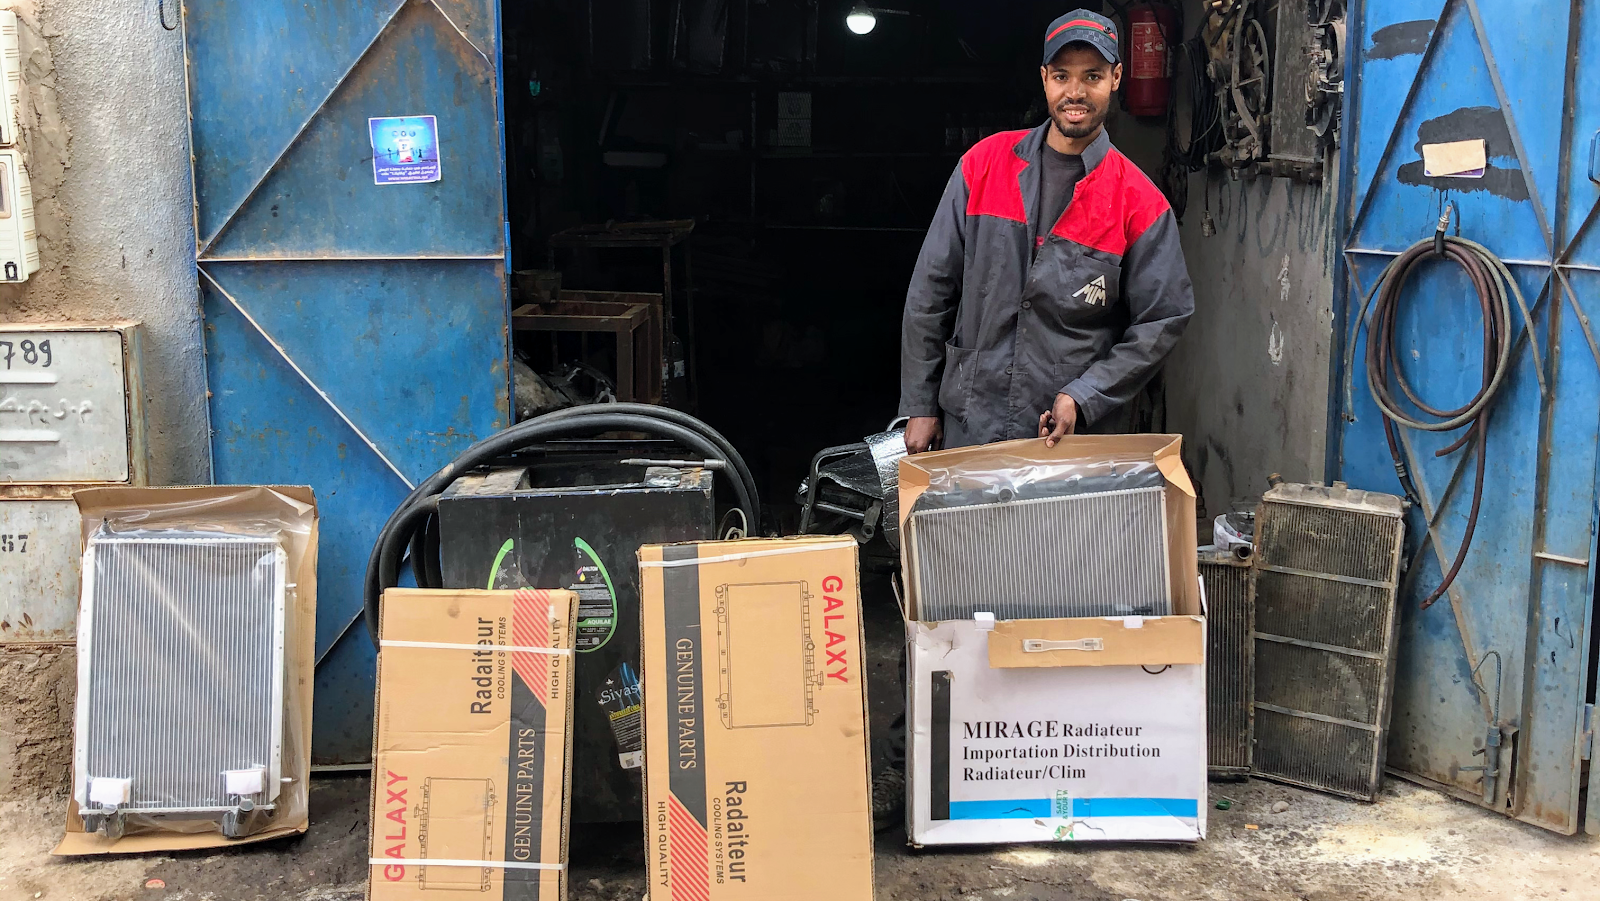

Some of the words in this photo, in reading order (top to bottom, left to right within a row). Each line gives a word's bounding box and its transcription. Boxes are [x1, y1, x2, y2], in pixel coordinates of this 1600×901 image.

[498, 616, 507, 658] SSTEMS
[552, 617, 561, 668] QUALITY
[821, 575, 849, 684] GALAXY
[470, 616, 494, 714] Radaiteur
[497, 659, 506, 700] COOLING
[551, 668, 560, 699] HIGH
[676, 638, 695, 714] GENUINE
[517, 728, 536, 779] PARTS
[678, 718, 697, 770] PARTS
[963, 720, 1059, 739] MIRAGE
[1063, 722, 1142, 737] Radiateur
[963, 745, 1058, 762] Importation
[1063, 743, 1161, 758] Distribution
[963, 765, 1086, 781] Radiateur/Clim
[384, 770, 408, 882] GALAXY
[513, 782, 533, 861] GENUINE
[657, 801, 666, 831] HIGH
[713, 797, 723, 839] COOLING
[725, 780, 749, 883] Radaiteur
[658, 834, 669, 888] QUALITY
[714, 841, 724, 885] SYSTEMS
